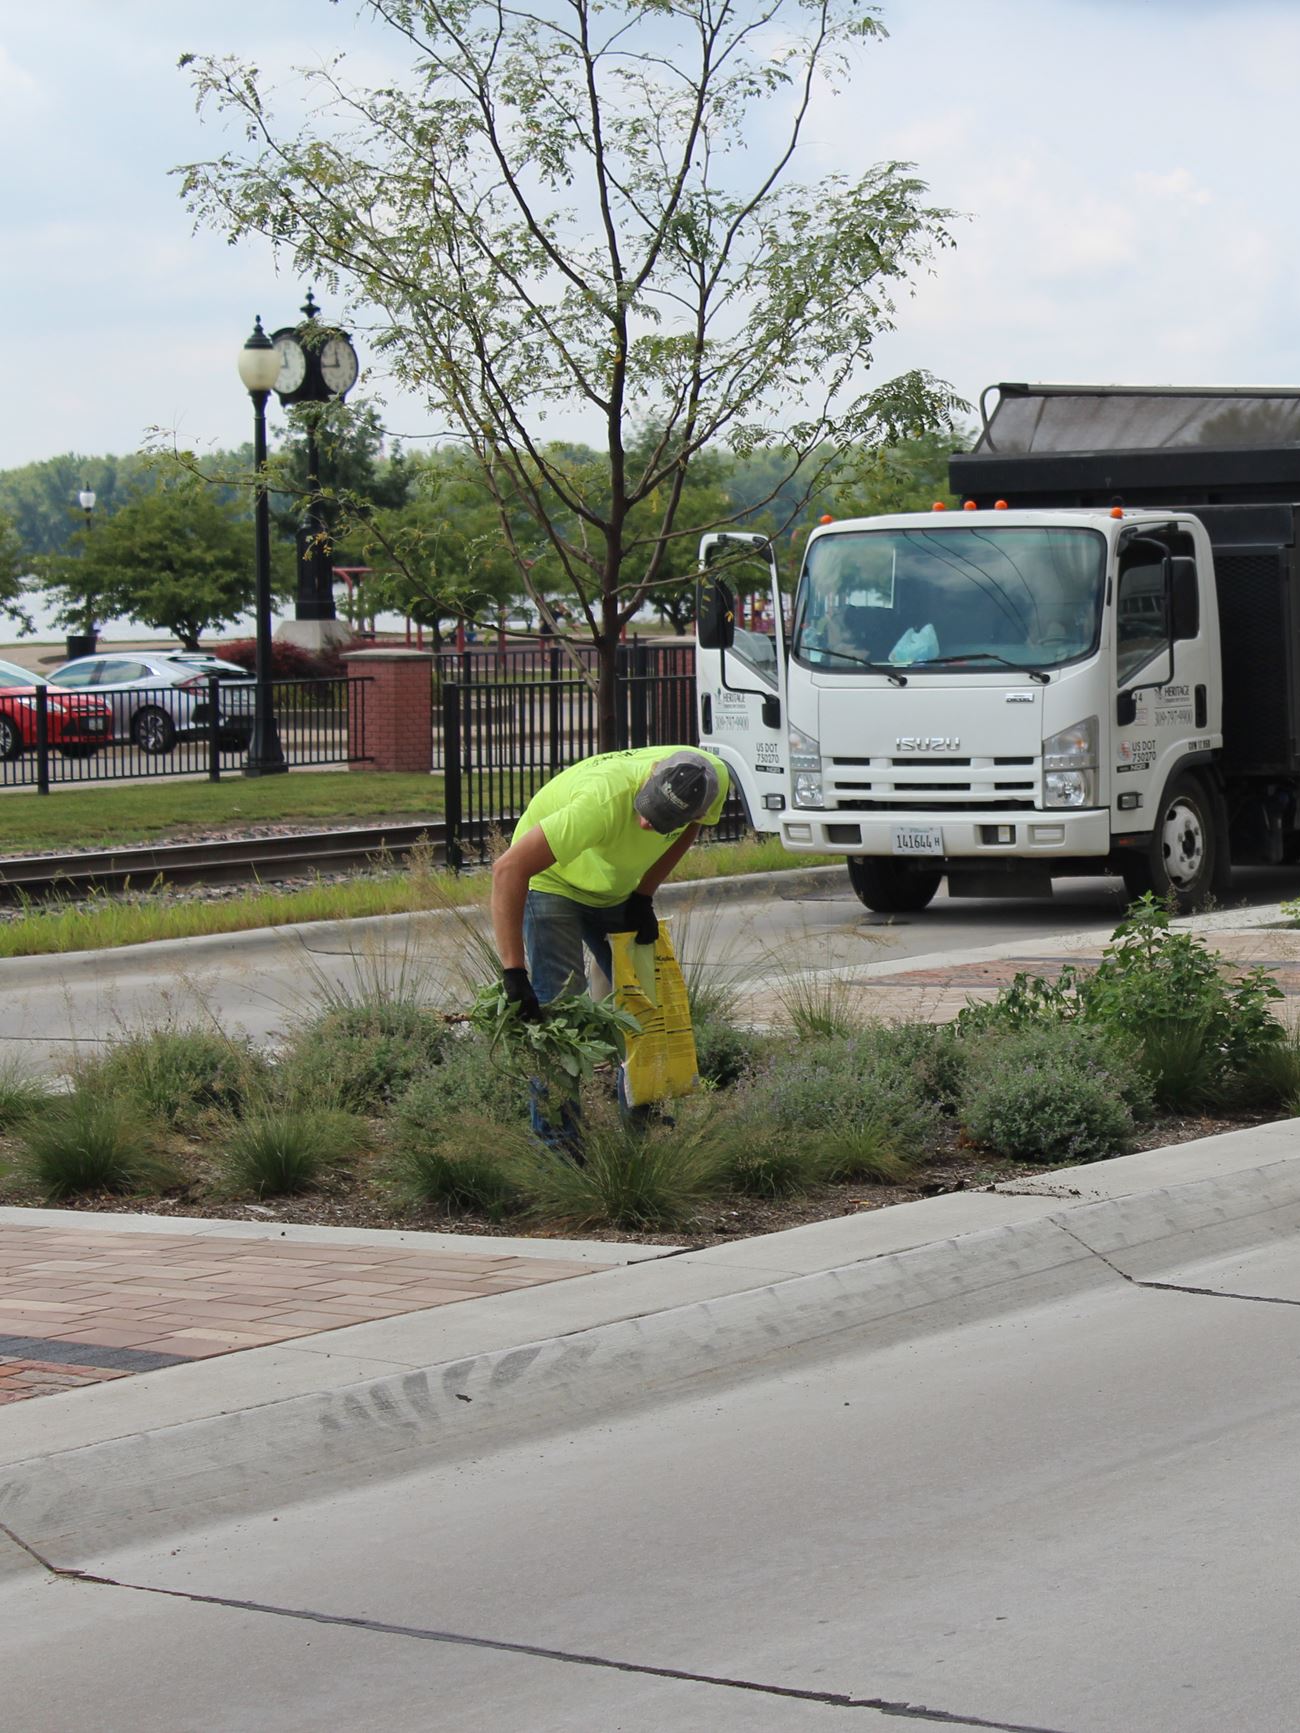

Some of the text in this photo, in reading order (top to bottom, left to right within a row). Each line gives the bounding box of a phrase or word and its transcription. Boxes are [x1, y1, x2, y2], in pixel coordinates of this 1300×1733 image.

[1164, 685, 1190, 697] HERITAGE
[756, 743, 778, 753] US DOT
[896, 737, 960, 752] ISUZU
[1132, 740, 1156, 752] US DOT
[757, 753, 780, 764] 750270
[1132, 751, 1156, 763] 750270
[897, 834, 940, 849] 141644 H
